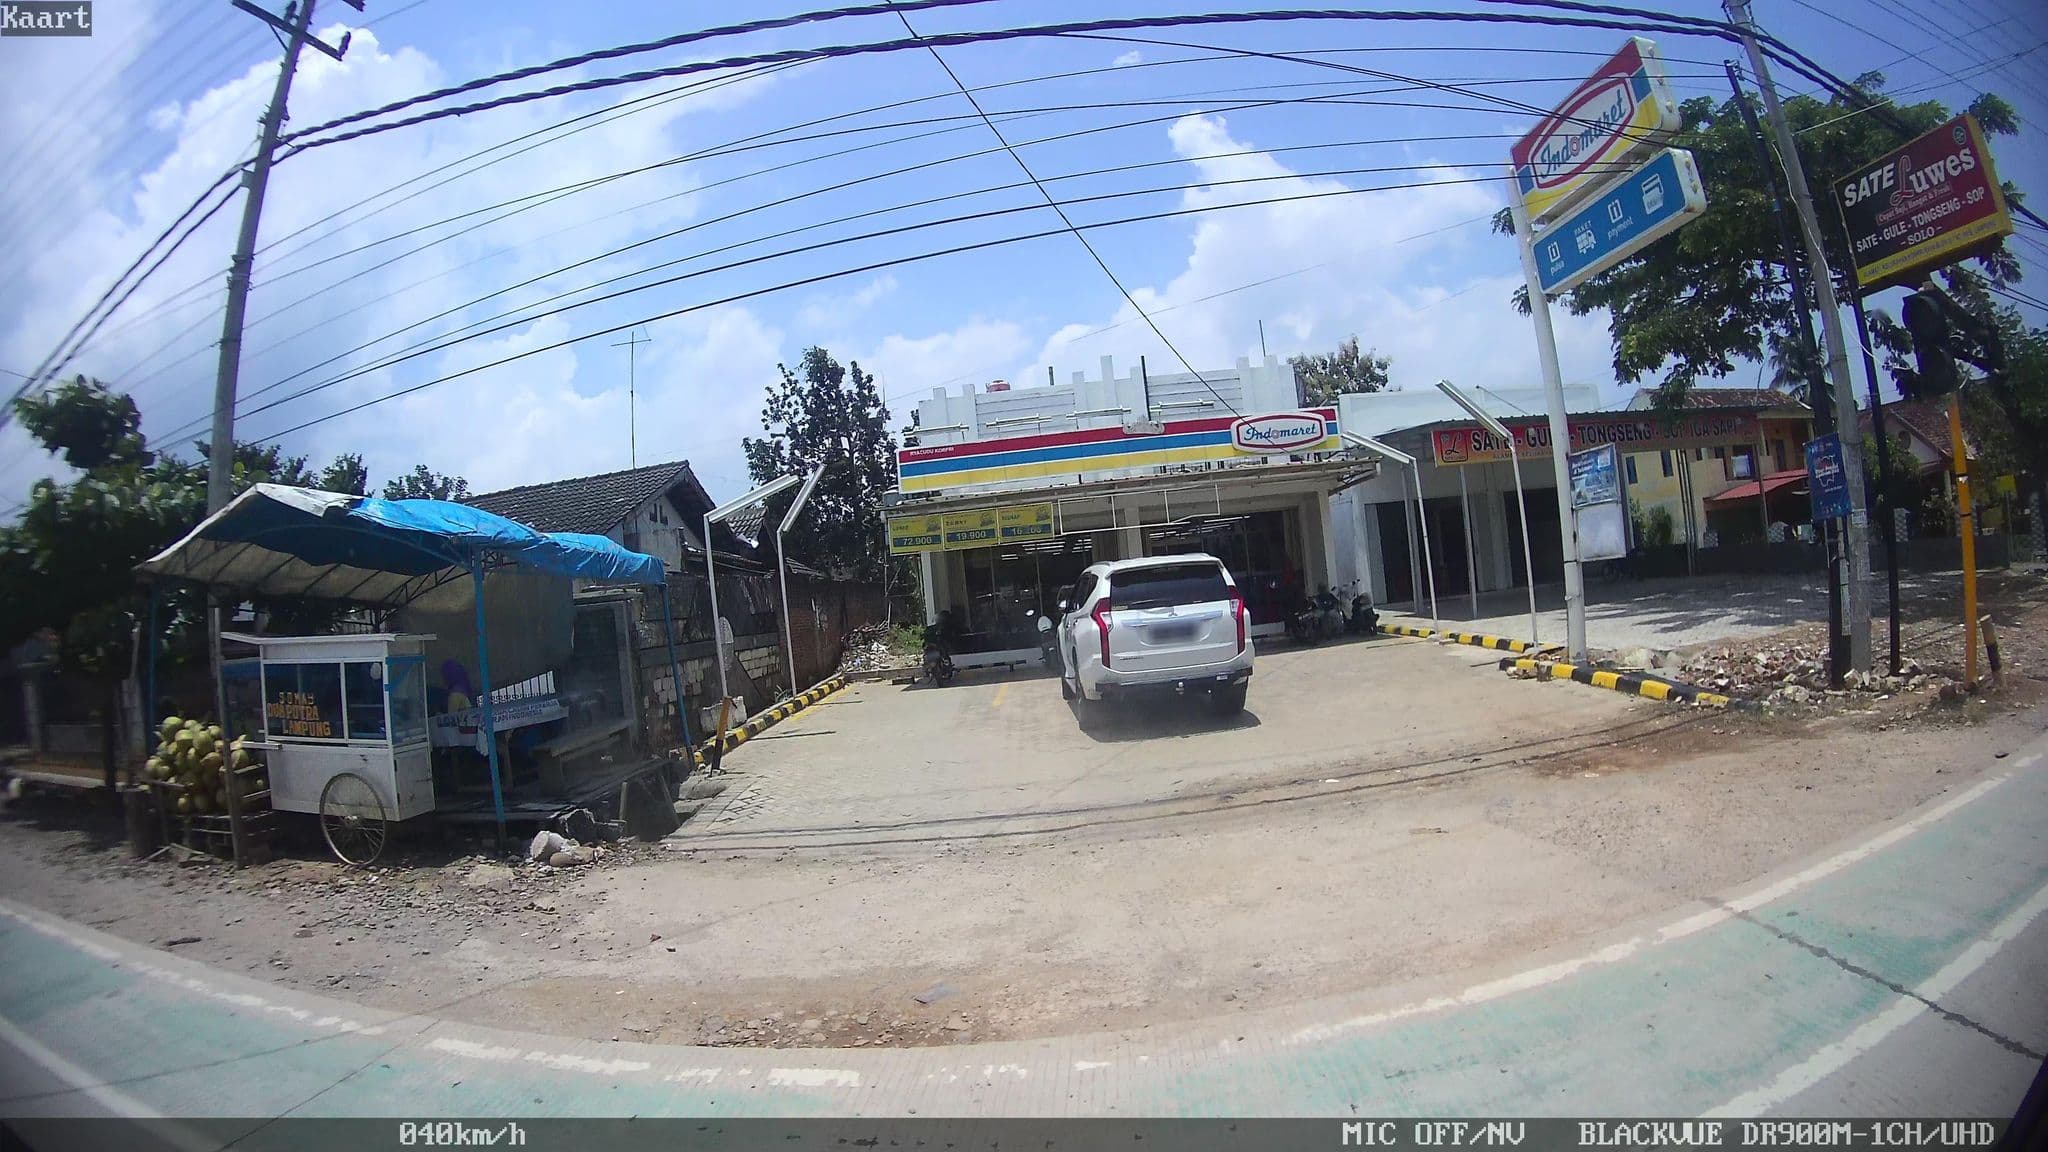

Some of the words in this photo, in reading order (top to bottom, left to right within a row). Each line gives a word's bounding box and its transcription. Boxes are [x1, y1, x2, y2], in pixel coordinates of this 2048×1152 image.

[1540, 88, 1627, 179] Indomaret
[1844, 162, 1895, 208] SATE
[1889, 147, 1976, 207] Luwes
[1856, 235, 1879, 253] SATE
[1883, 221, 1907, 241] GULE
[1912, 197, 1961, 229] TONGSENG
[1966, 186, 1985, 206] SOP
[1908, 226, 1935, 246] SOLO
[1243, 423, 1317, 441] Indomaret
[1578, 423, 1650, 444] TONGSENG
[903, 536, 932, 546] 72.900
[956, 531, 987, 541] 19.900
[282, 719, 332, 737] LAMPUNG
